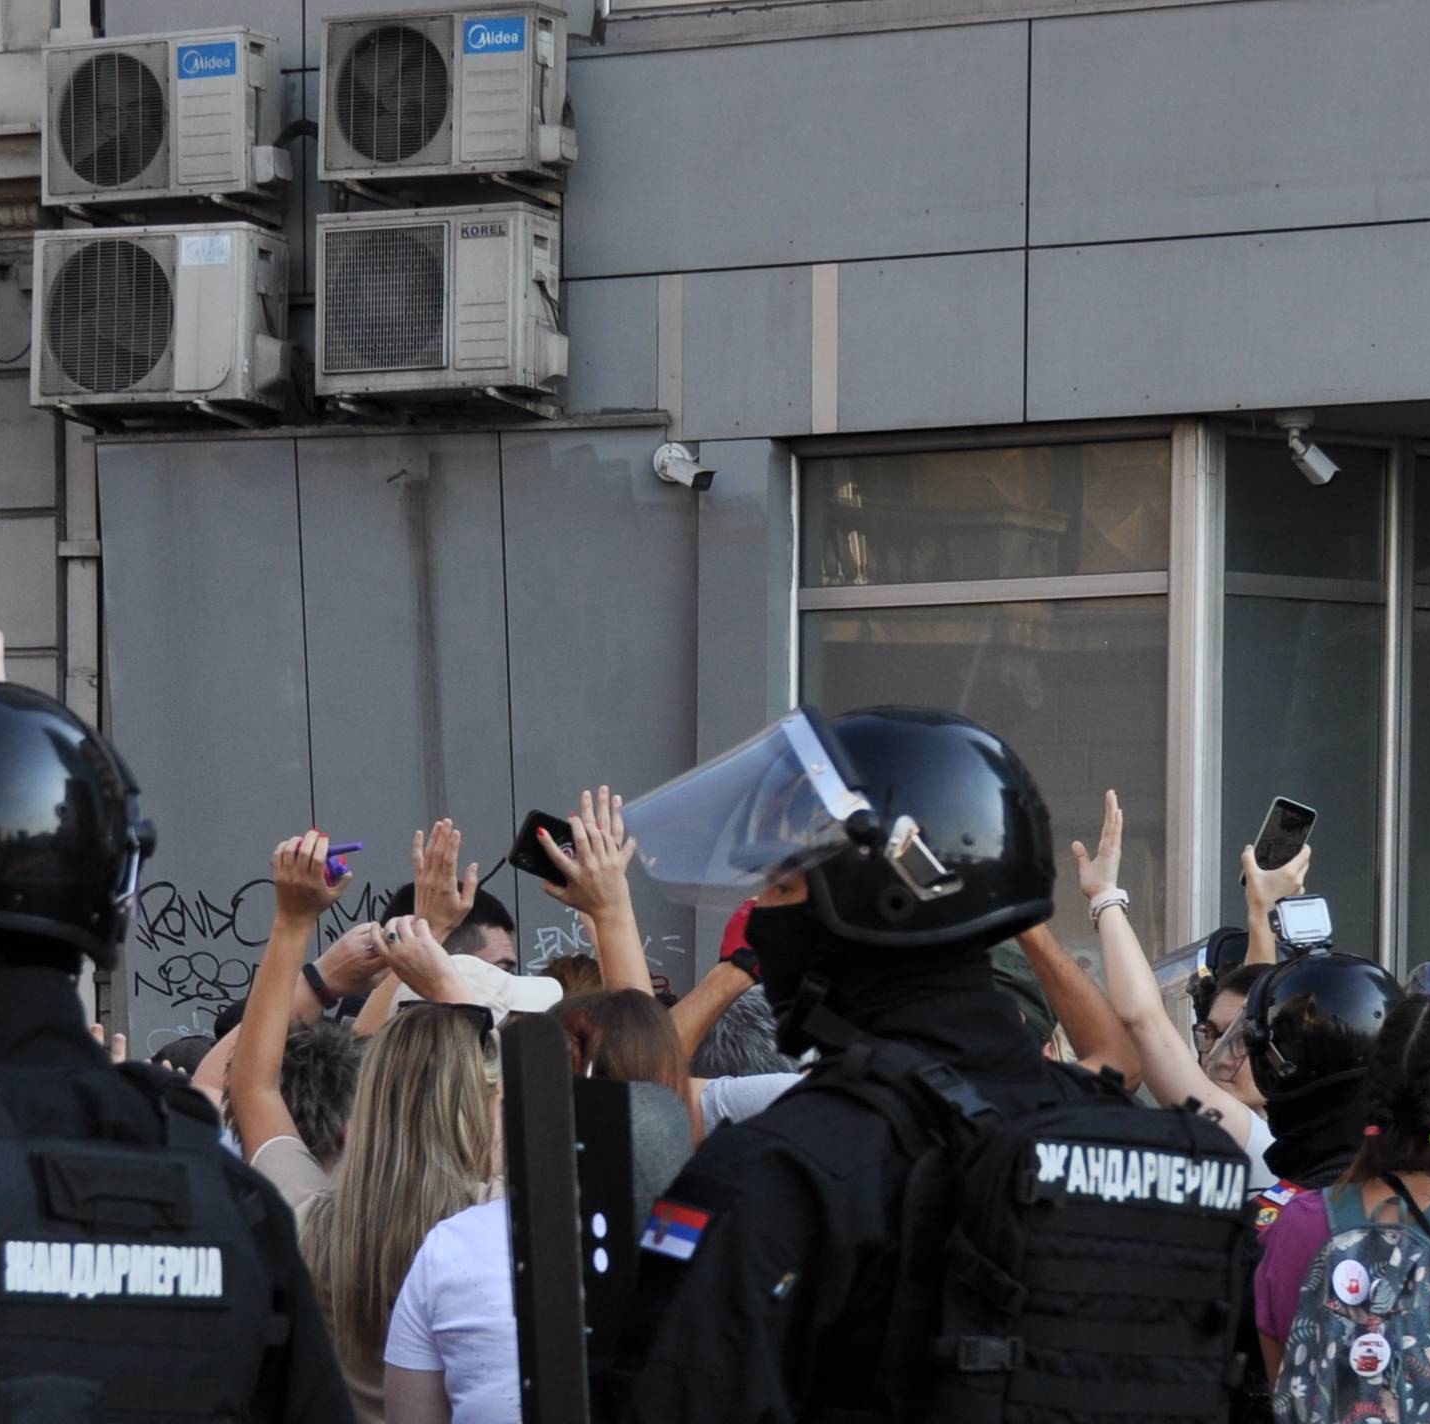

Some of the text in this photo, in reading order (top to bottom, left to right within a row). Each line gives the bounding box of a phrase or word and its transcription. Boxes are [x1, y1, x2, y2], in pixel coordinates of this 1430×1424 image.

[467, 24, 519, 49] Midea
[182, 50, 231, 73] Midea
[461, 224, 506, 239] KOREL
[5, 1240, 223, 1299] ЖАНДАРМЕРИЈА
